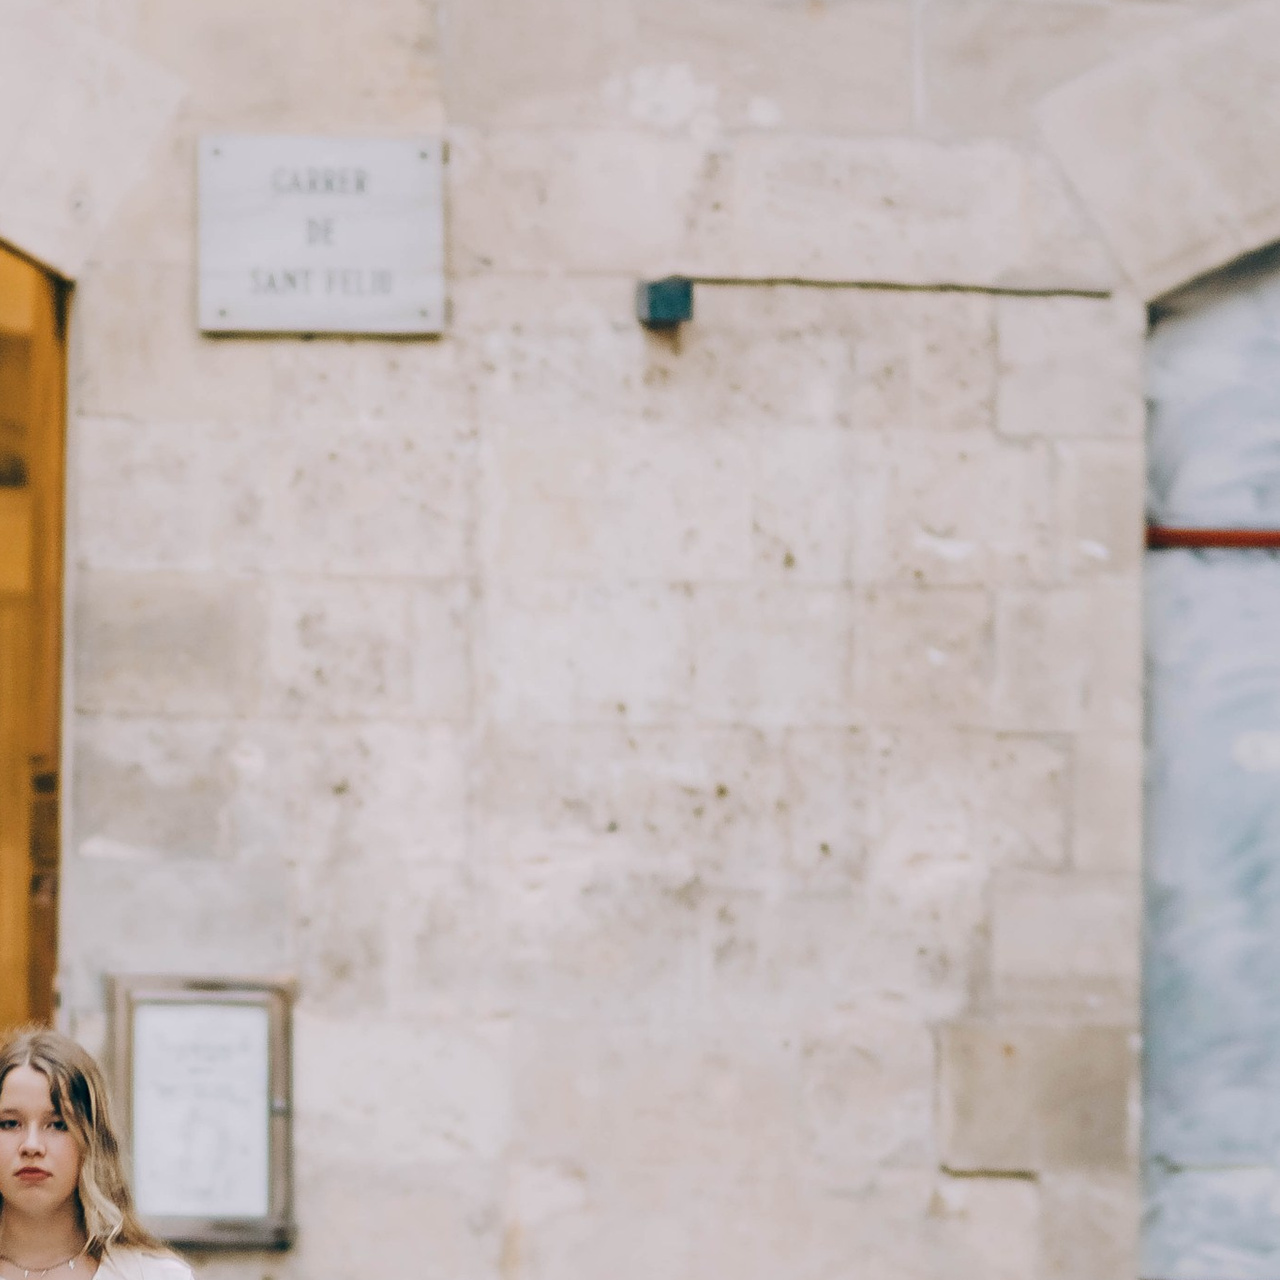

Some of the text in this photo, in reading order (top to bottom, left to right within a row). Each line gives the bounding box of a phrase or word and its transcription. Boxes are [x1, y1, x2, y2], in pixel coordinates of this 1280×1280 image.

[271, 167, 368, 194] CARRER
[306, 218, 335, 245] DE
[250, 268, 312, 295] SANT
